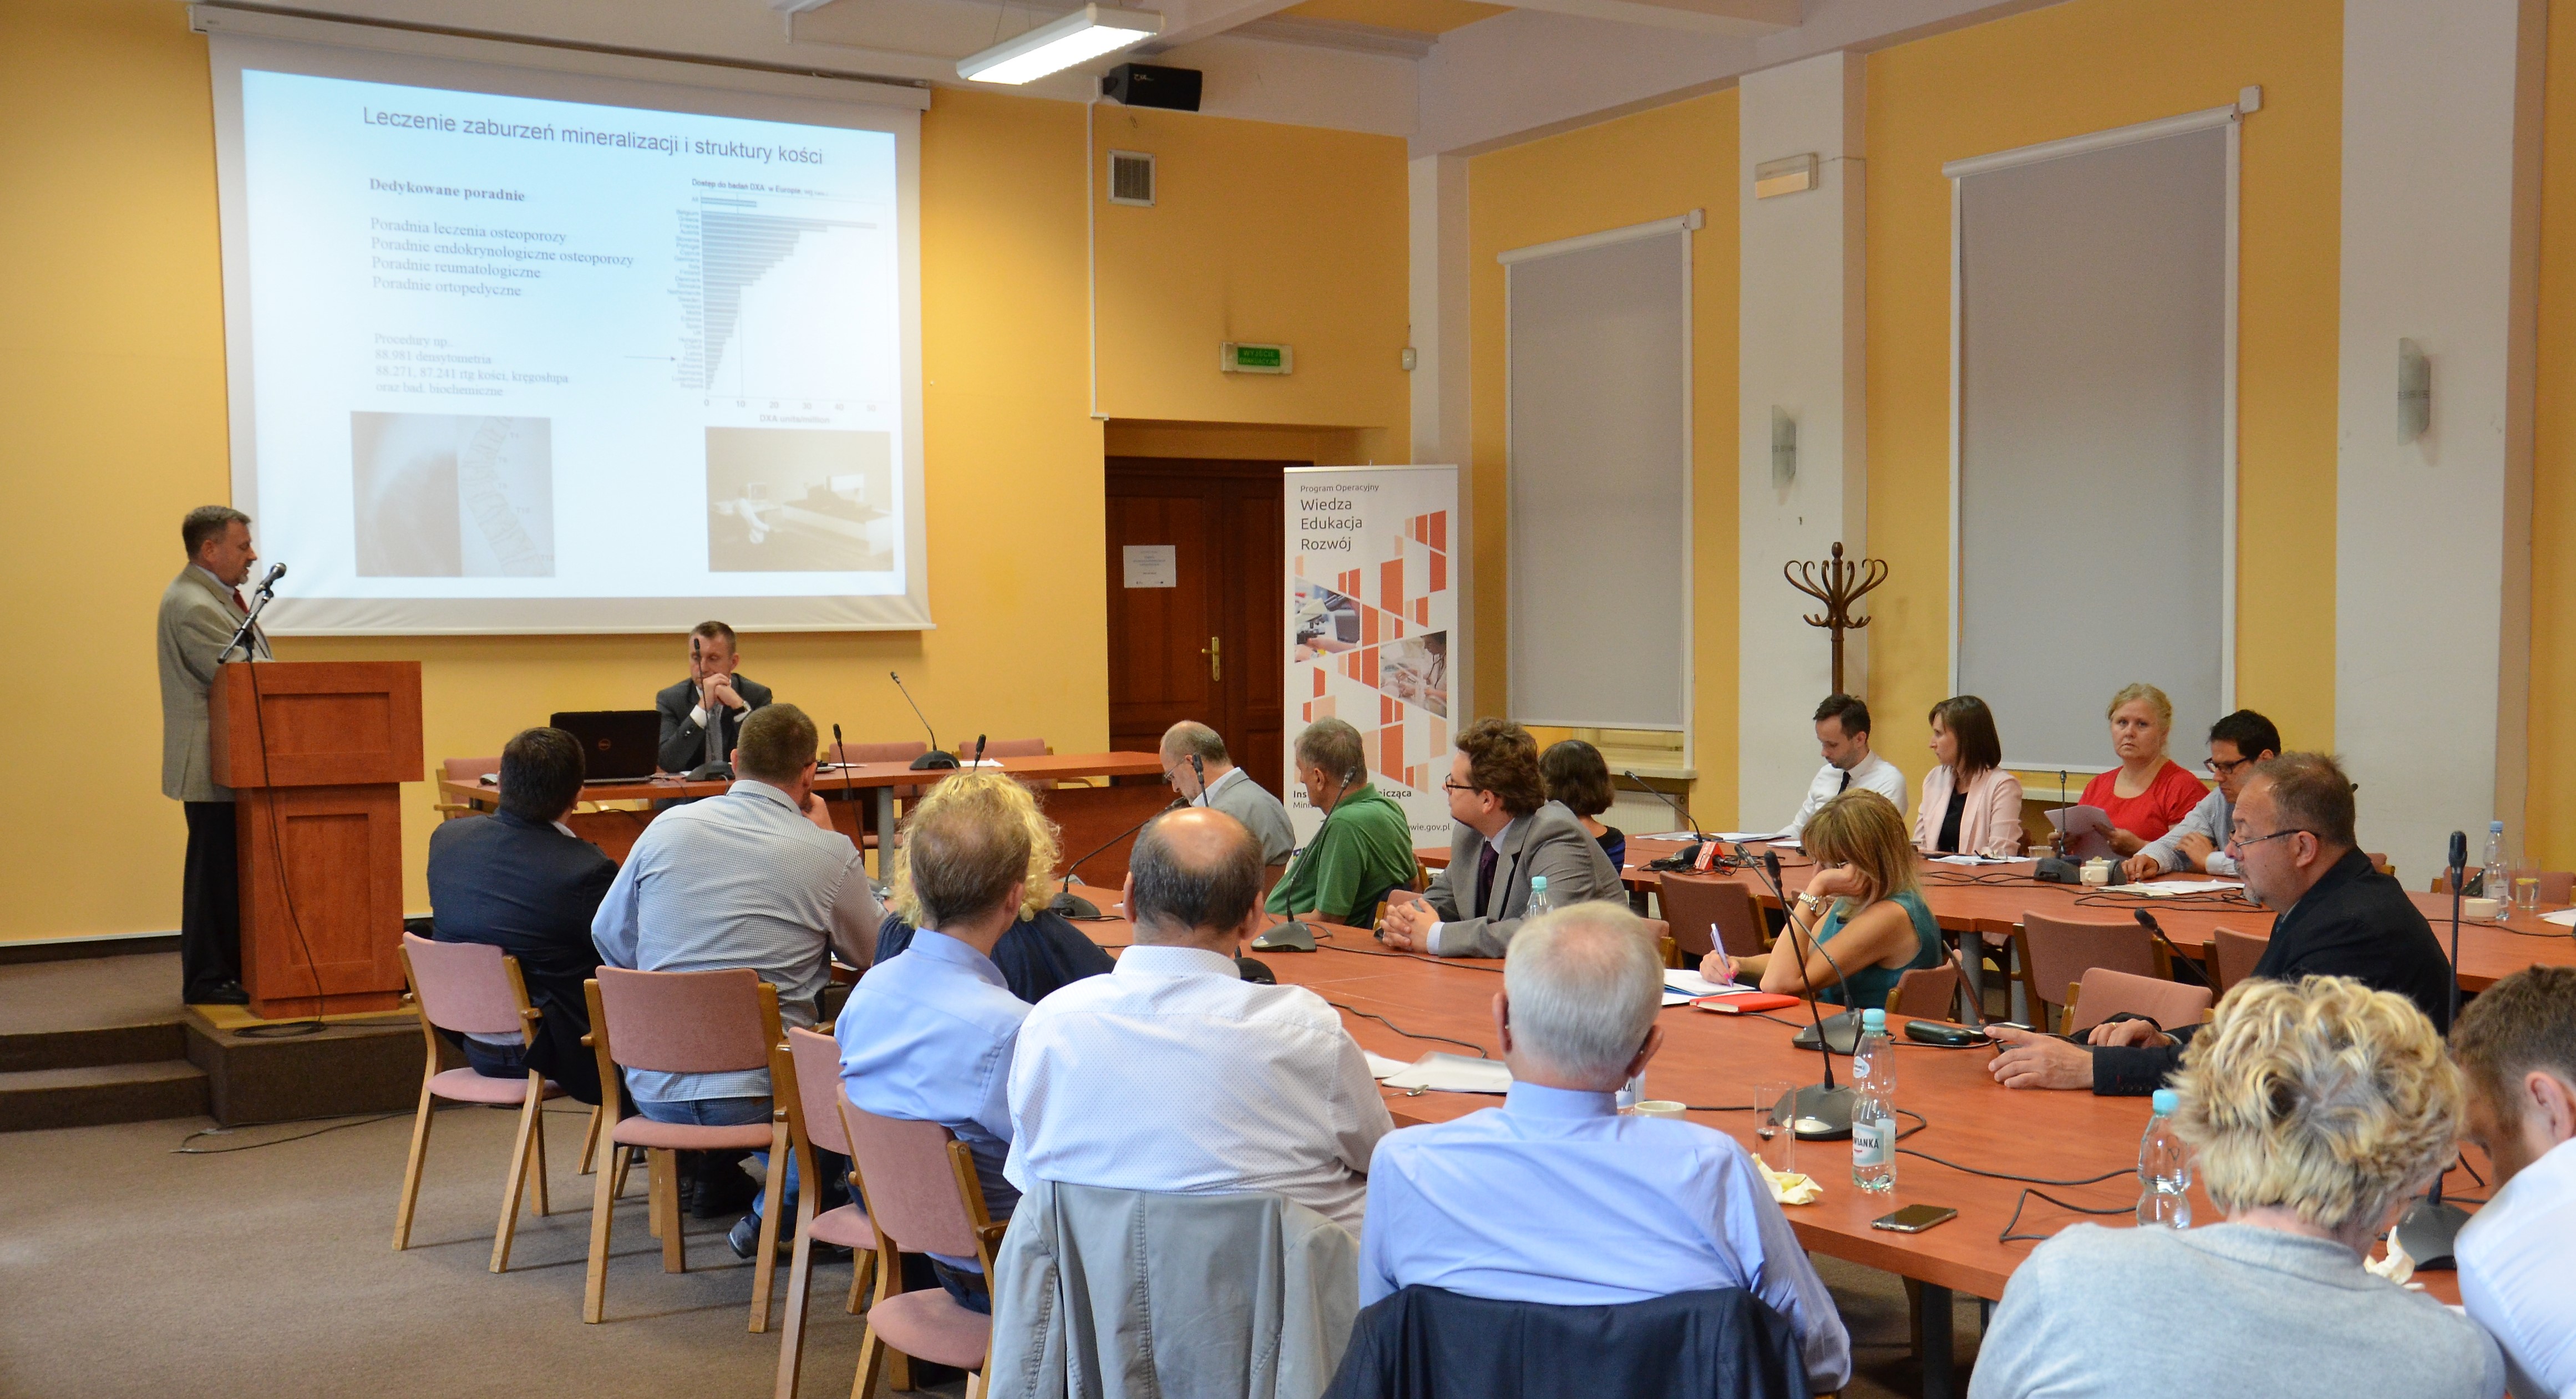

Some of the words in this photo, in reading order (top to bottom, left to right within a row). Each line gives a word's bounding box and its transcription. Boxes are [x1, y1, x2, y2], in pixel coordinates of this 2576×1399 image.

[363, 106, 456, 132] Leczenie
[463, 118, 555, 141] zaburzeń
[561, 127, 678, 156] mineralizacji
[685, 137, 689, 153] i
[695, 139, 772, 165] struktury
[779, 145, 823, 165] kości
[369, 178, 460, 197] Dedykowane
[464, 186, 525, 202] poradnie
[751, 183, 764, 191] DXA
[371, 217, 429, 234] Poradnia
[434, 222, 486, 237] leczenia
[490, 228, 566, 243] osteoporozy
[371, 237, 430, 253] Poradnie
[434, 242, 555, 262] endokrynologiczne
[560, 251, 634, 267] osteoporozy
[372, 256, 430, 272] Poradnie
[435, 261, 541, 278] reumatologiczne
[372, 276, 431, 292] Poradnie
[435, 282, 521, 297] ortopedyczne
[374, 333, 430, 348] Procedury
[375, 349, 412, 361] 88.981
[415, 351, 492, 366] densytometria
[420, 367, 456, 379] 87.241
[512, 371, 569, 385] kręgosłupa
[376, 383, 399, 393] oraz
[429, 383, 504, 396] biochemiczne
[769, 401, 779, 409] 20
[802, 402, 812, 410] 30
[834, 403, 844, 411] 40
[759, 414, 778, 423] DXA
[779, 415, 831, 425] units/million
[1336, 484, 1379, 492] Operacyjny
[1301, 497, 1352, 511] Wiedza
[1301, 516, 1362, 531] Edukacja
[1301, 537, 1351, 552] Rozwój
[1378, 788, 1412, 798] icząca
[1410, 823, 1450, 832] wie.gov.pl
[1854, 1137, 1879, 1149] WIANKA
